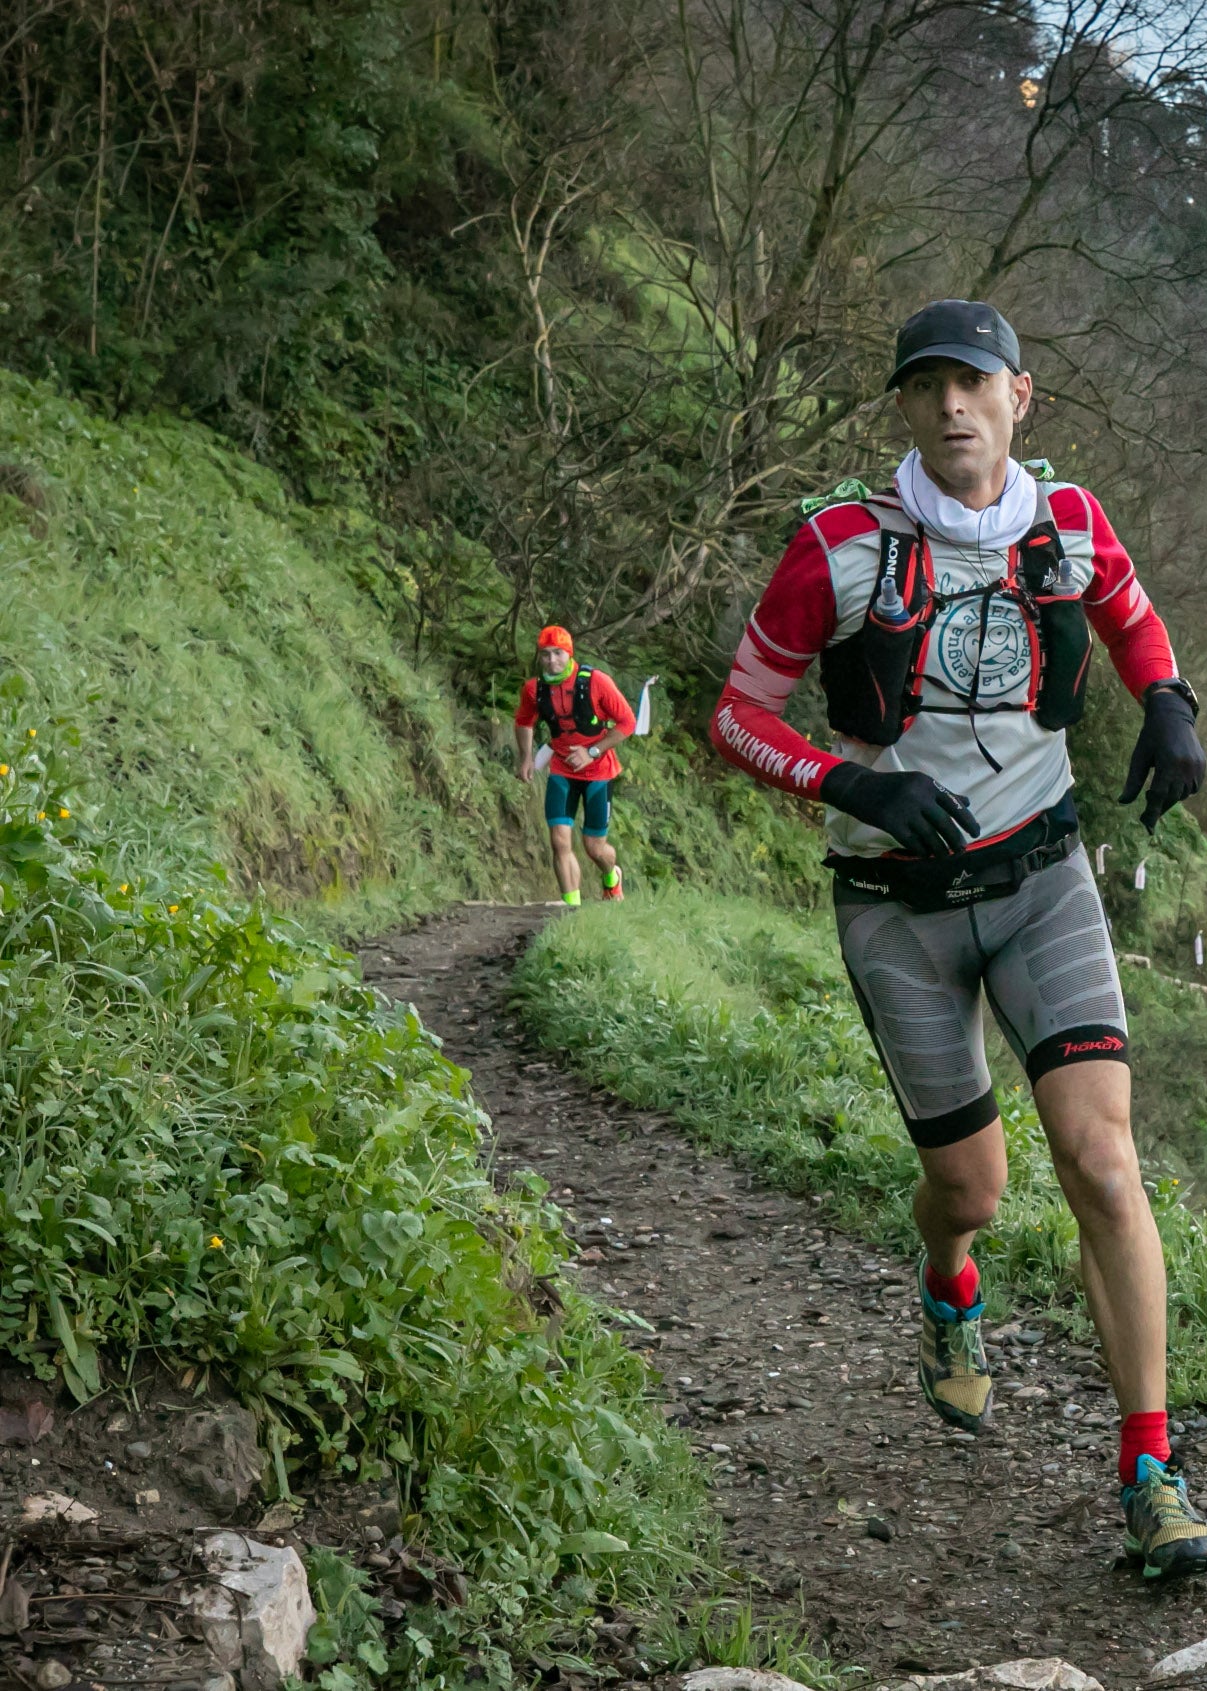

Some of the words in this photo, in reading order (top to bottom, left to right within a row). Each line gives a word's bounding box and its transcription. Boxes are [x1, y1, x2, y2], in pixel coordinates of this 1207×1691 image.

[886, 536, 900, 578] AONI
[963, 607, 980, 626] al
[990, 605, 1026, 630] ELA
[982, 673, 1006, 688] La
